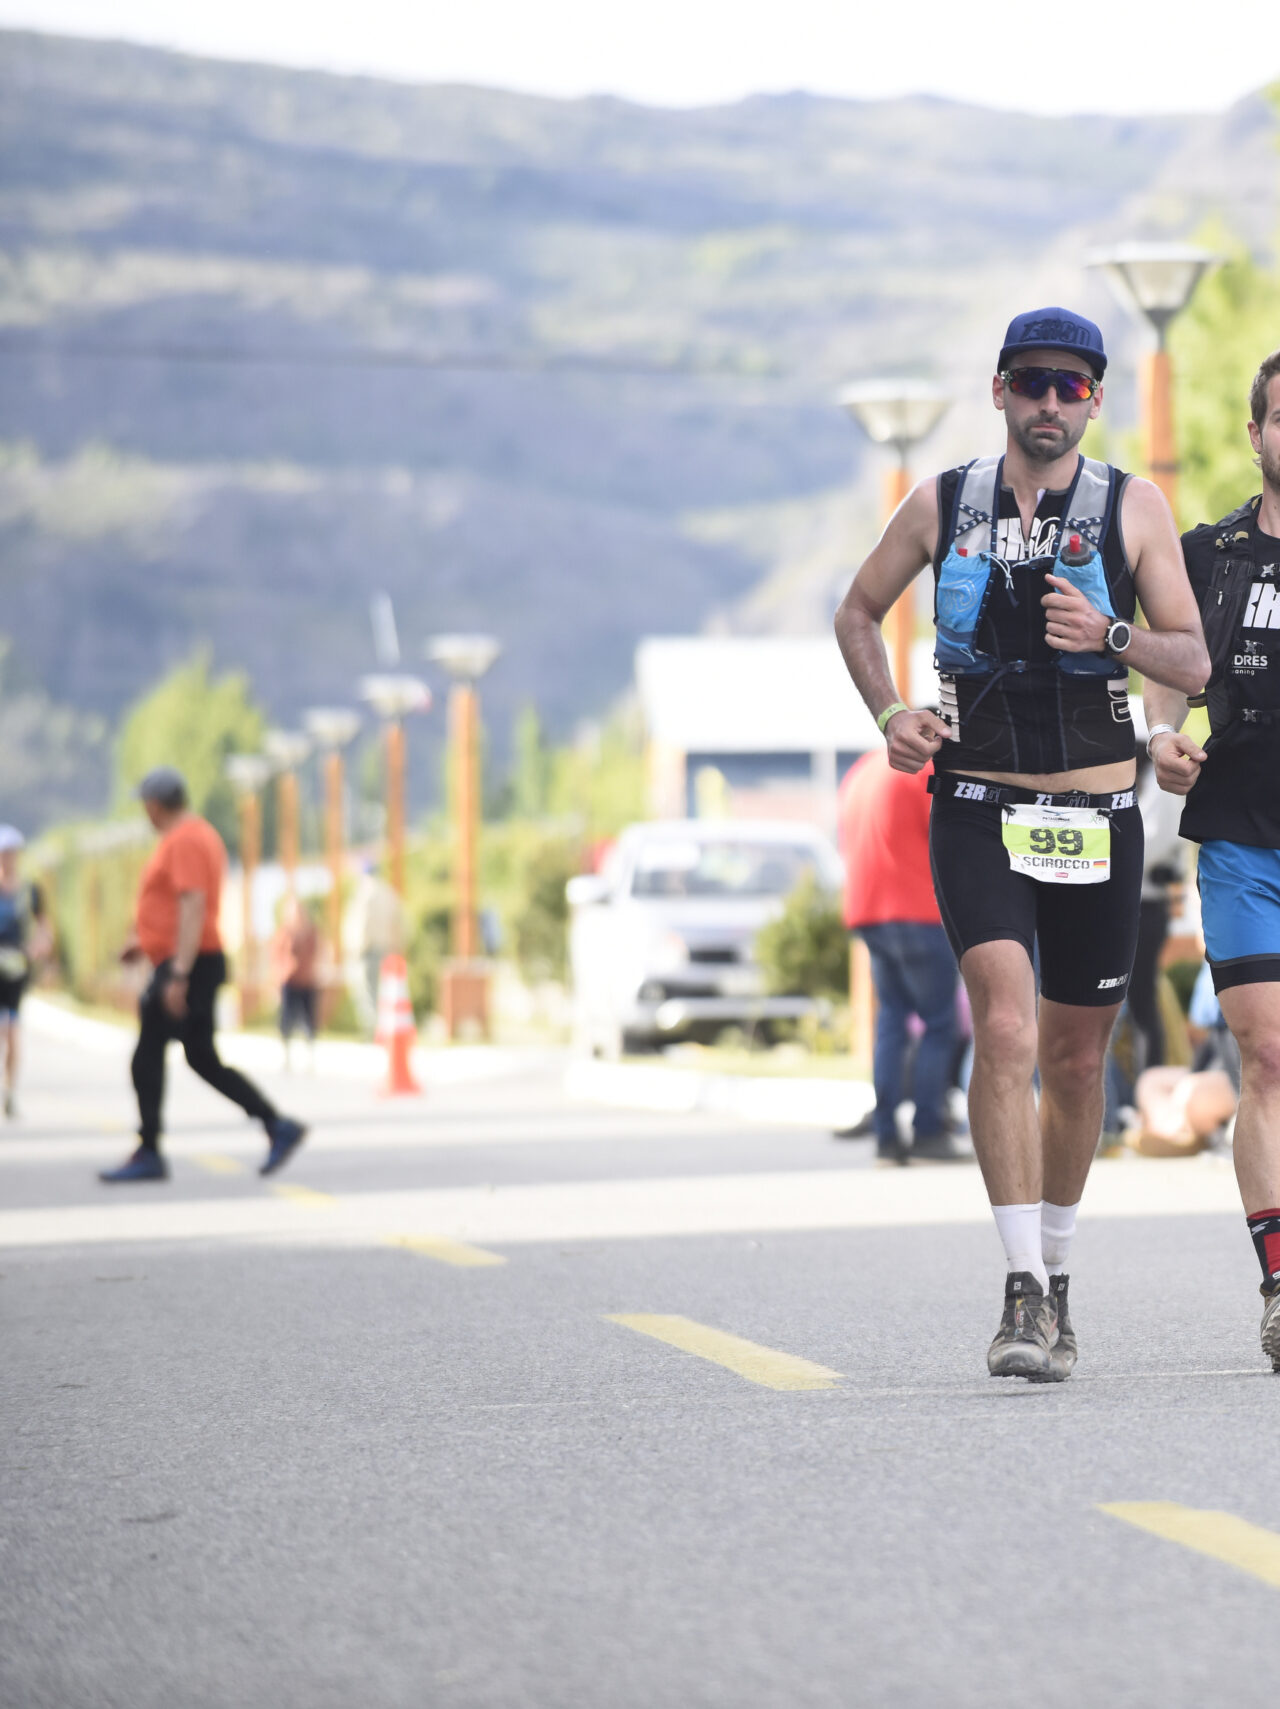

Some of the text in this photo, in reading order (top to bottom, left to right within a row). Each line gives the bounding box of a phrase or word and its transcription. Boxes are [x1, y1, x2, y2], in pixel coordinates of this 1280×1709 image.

[1232, 654, 1268, 667] DRES
[1233, 668, 1255, 676] aning
[1029, 828, 1084, 856] 99
[1023, 856, 1090, 870] SCIROCCO
